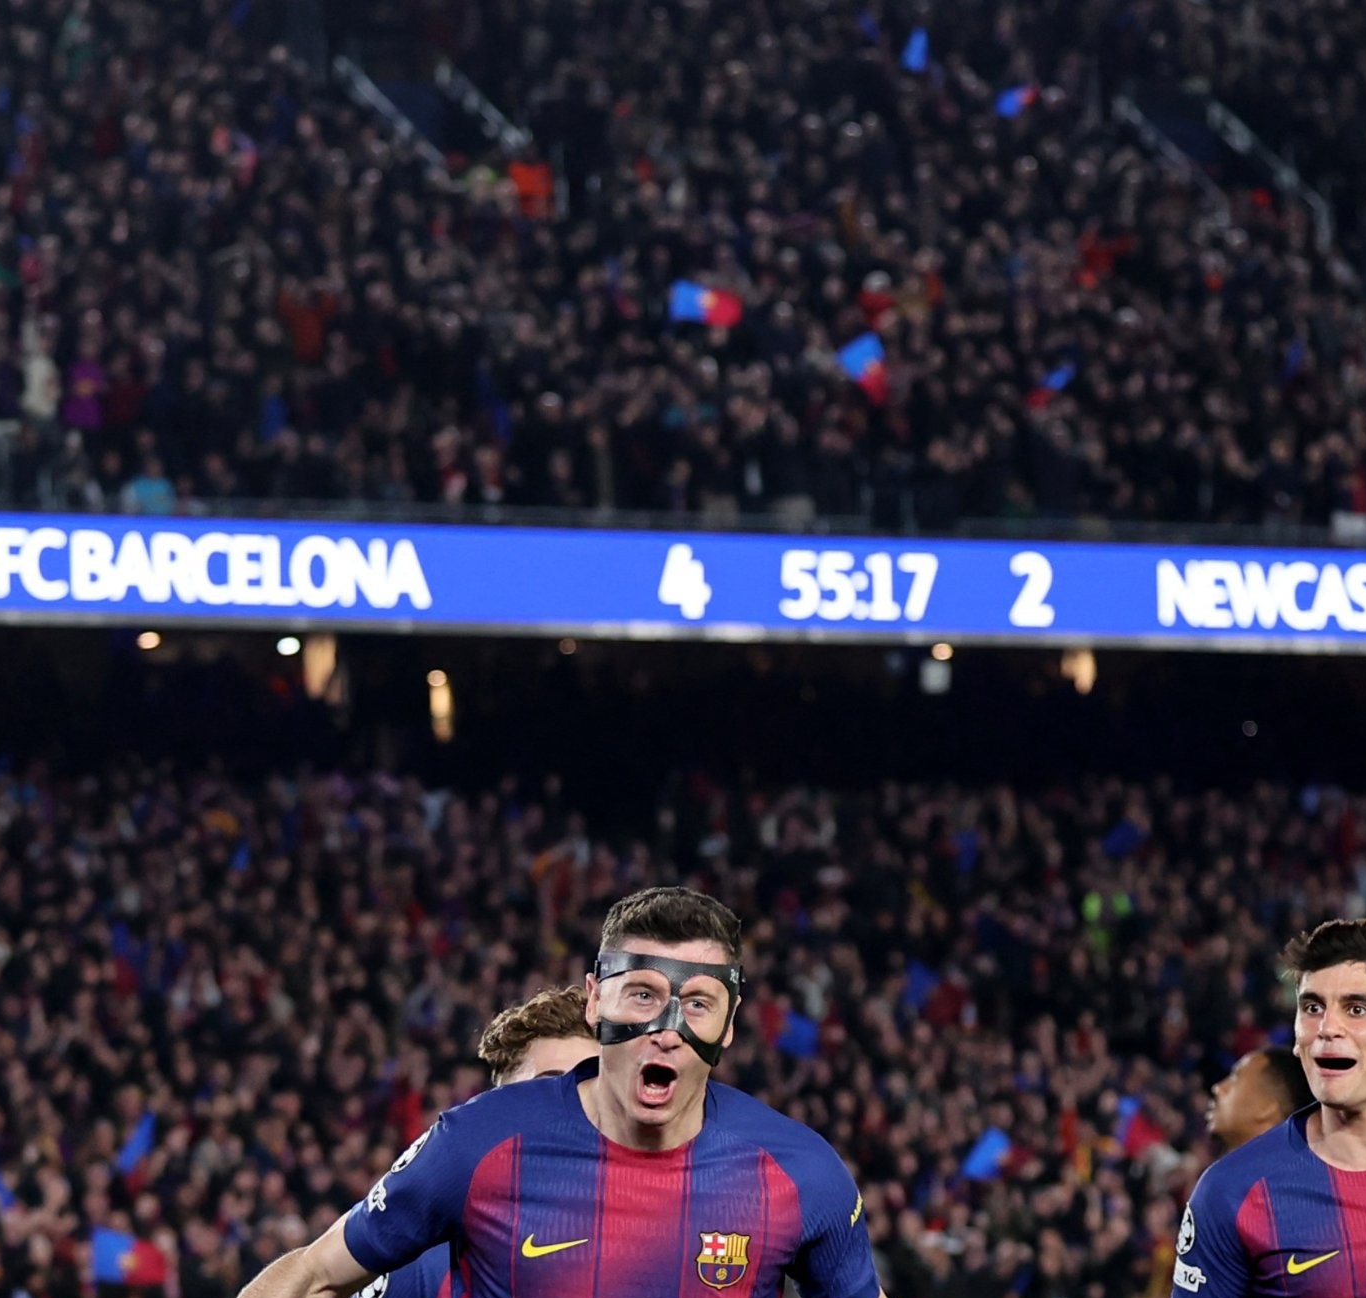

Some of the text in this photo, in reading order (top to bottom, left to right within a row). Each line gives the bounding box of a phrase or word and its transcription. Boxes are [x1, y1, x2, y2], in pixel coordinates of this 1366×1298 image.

[70, 530, 433, 610] BARCELONA
[658, 545, 1055, 627] 4 55:17 2
